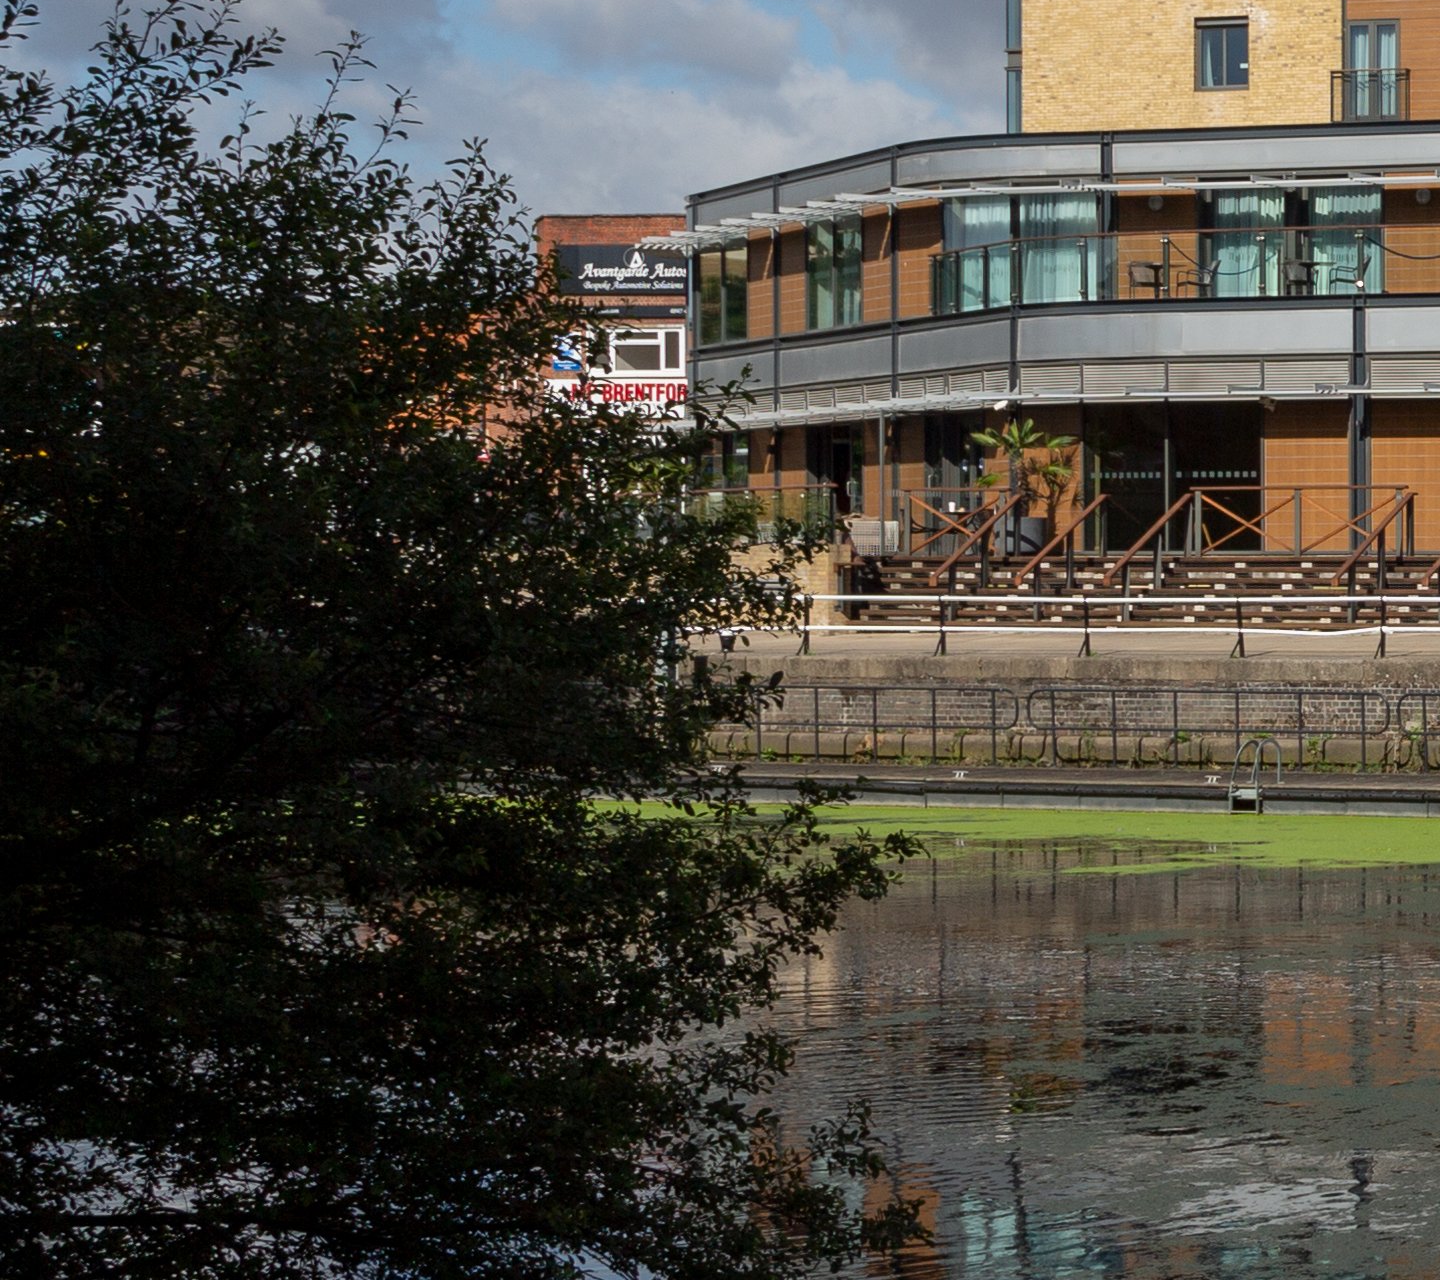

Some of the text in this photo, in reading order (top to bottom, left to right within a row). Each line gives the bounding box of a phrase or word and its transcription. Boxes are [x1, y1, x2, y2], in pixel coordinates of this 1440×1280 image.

[578, 263, 686, 281] Avantgarde Autos
[583, 281, 684, 291] Bespoke Automotive Solutions
